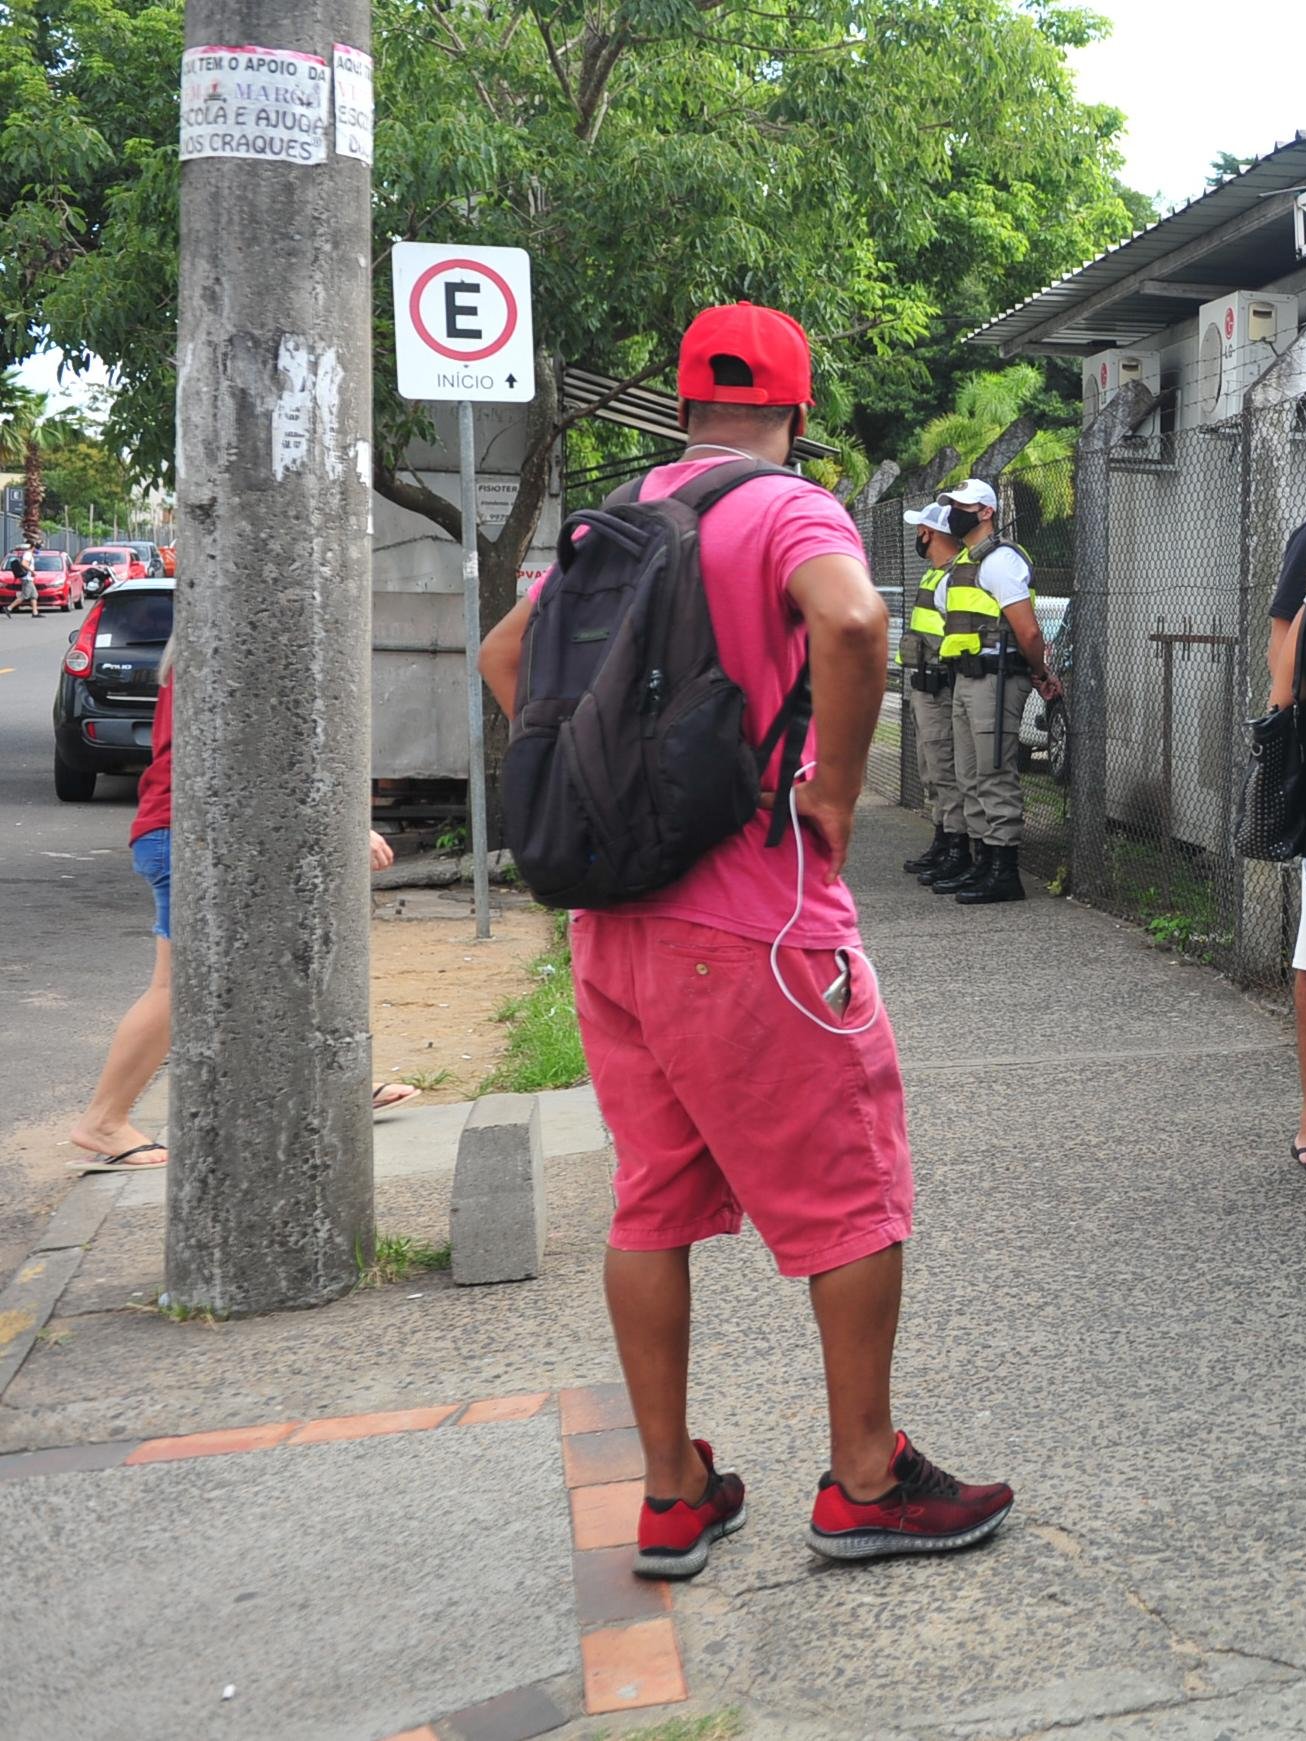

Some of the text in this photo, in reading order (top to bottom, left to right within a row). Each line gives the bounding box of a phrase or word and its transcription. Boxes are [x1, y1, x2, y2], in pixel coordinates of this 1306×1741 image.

[228, 57, 239, 70] O
[244, 58, 297, 77] APOIO
[308, 67, 326, 82] DA
[185, 106, 327, 135] COLA E AJUDA
[209, 133, 312, 160] CRAQUES
[444, 281, 483, 340] E
[437, 371, 494, 390] INÍCIO
[478, 485, 518, 493] FISIOTER
